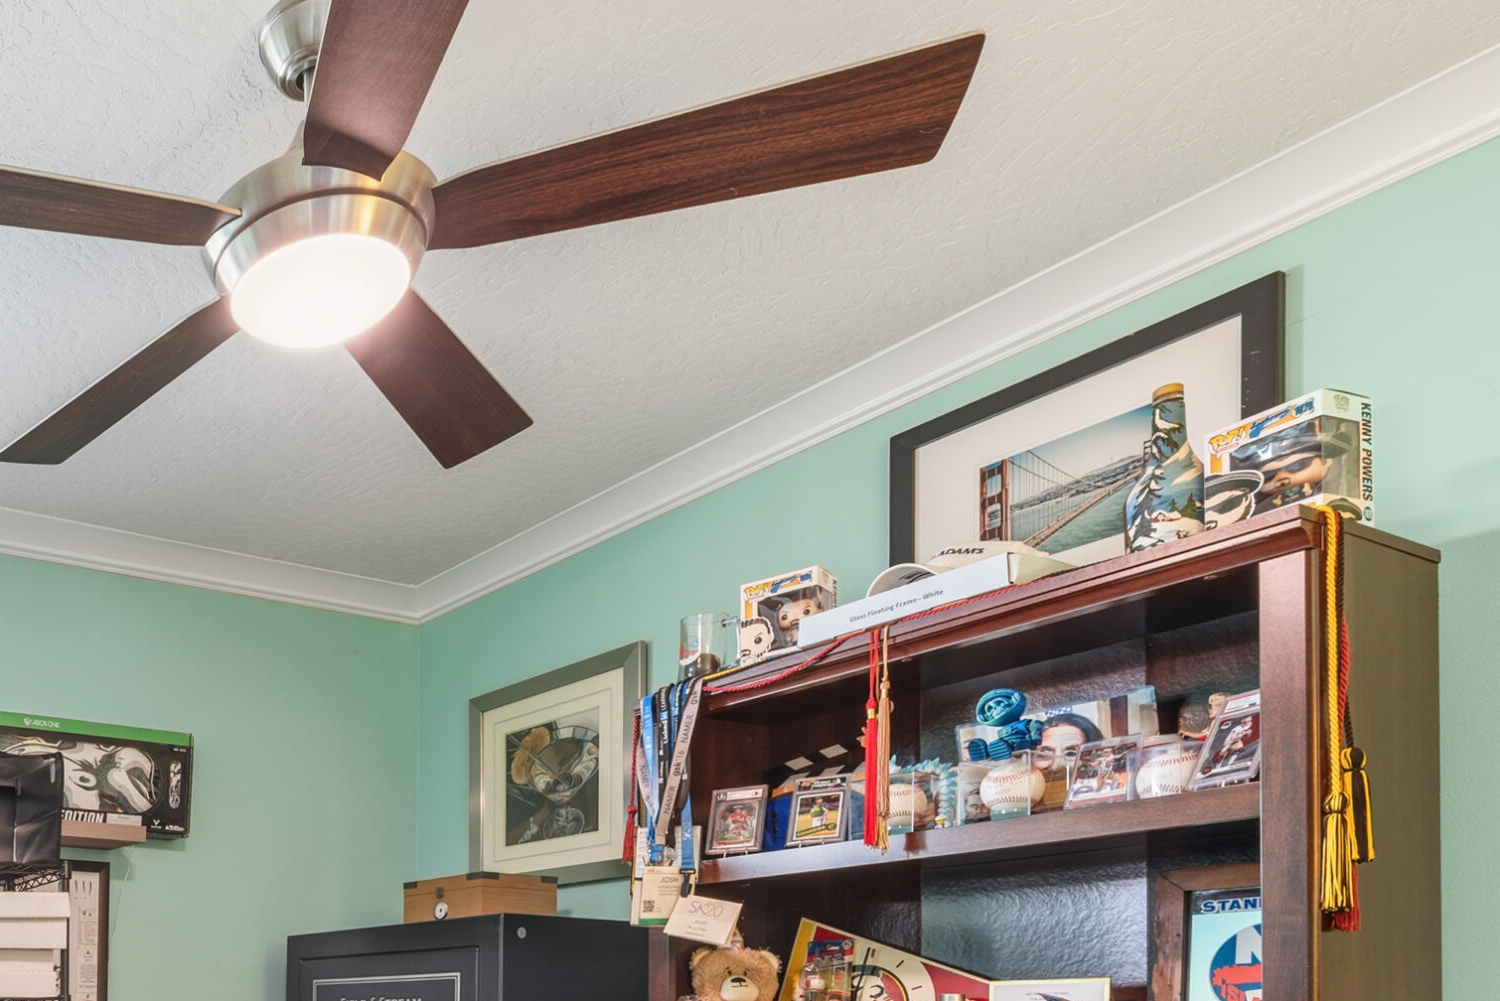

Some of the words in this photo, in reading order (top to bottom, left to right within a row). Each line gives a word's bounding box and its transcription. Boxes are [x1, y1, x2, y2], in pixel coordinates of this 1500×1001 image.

[1360, 402, 1372, 446] KENNY
[1361, 449, 1373, 502] POWERS
[849, 613, 866, 623] Glass
[867, 604, 894, 617] Floating
[895, 598, 917, 609] Frame
[922, 589, 944, 600] White
[681, 714, 694, 744] NAMER
[1202, 898, 1262, 913] STAN
